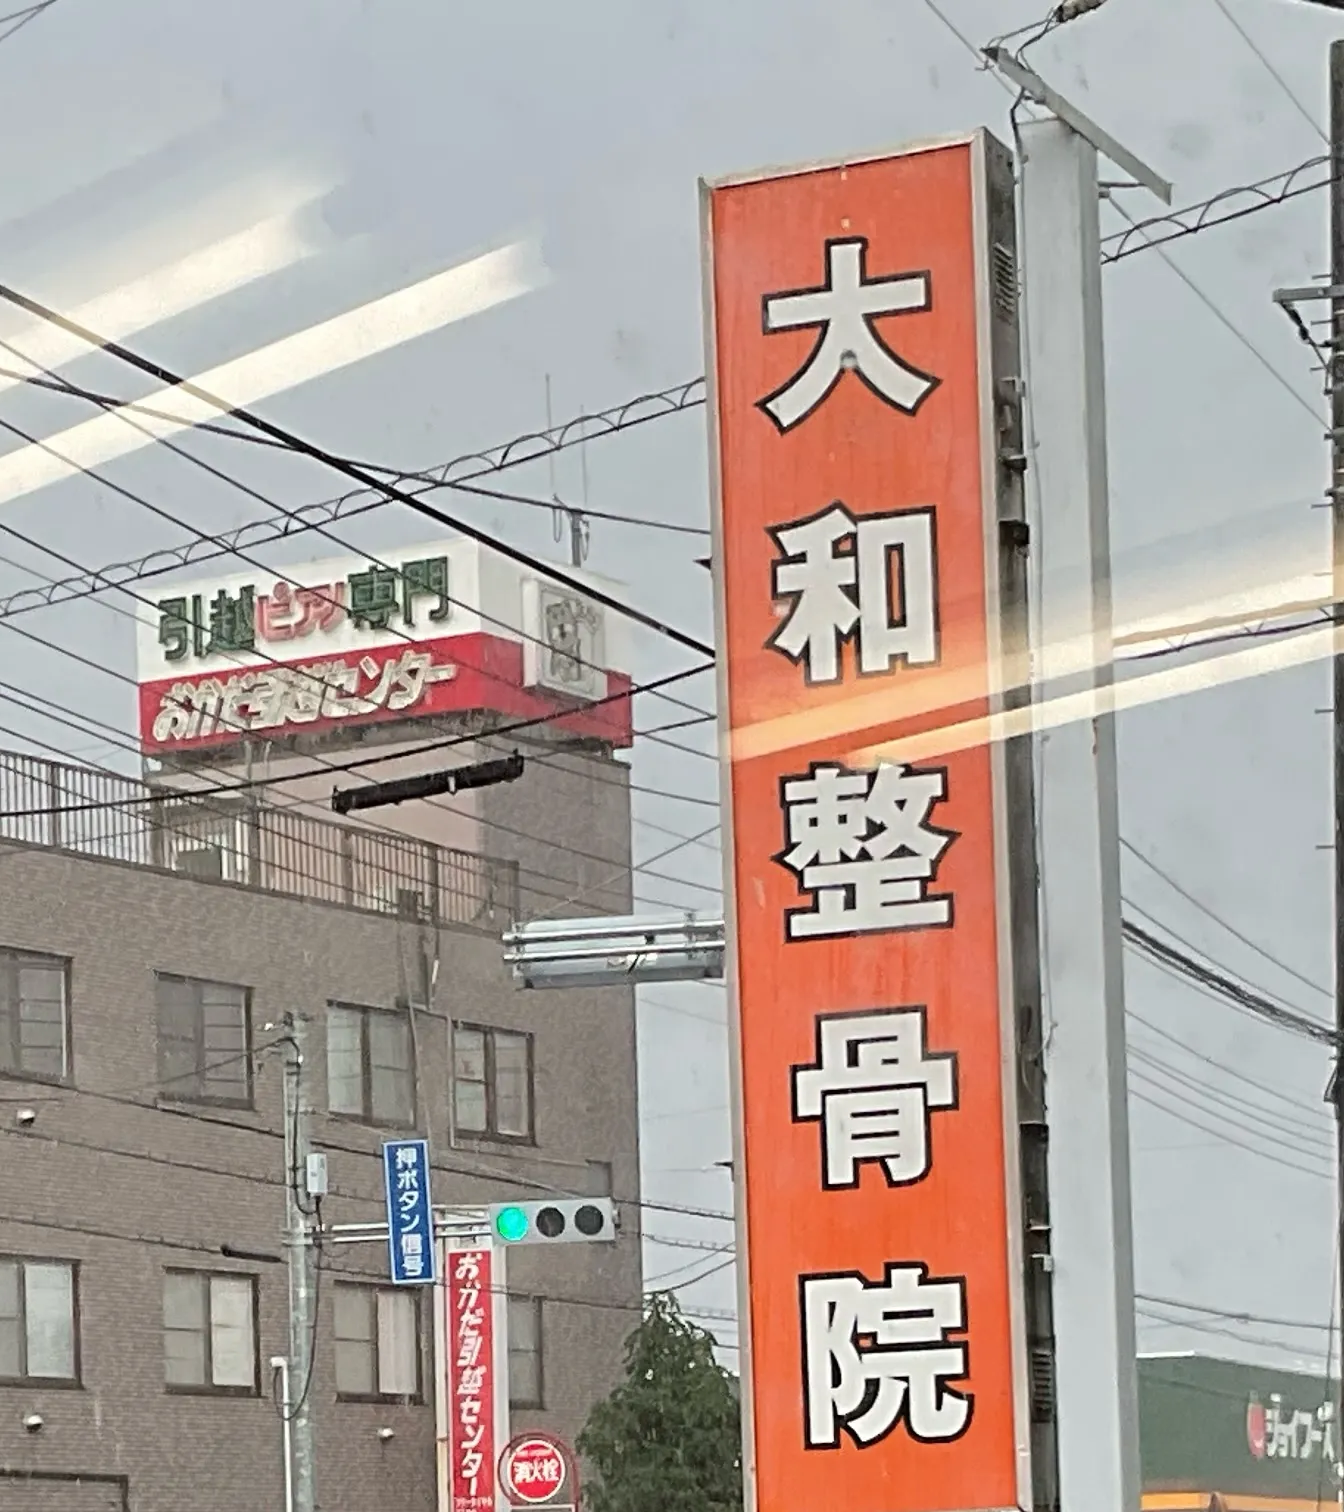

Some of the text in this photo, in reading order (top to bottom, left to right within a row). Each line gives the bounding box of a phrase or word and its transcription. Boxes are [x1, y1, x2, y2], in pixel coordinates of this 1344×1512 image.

[157, 556, 450, 660] 引越ピアノ専門
[761, 237, 974, 1450] 大和整骨院
[395, 1147, 425, 1277] 押ボタン信号
[455, 1252, 487, 1497] おかだ引越センター
[512, 1456, 560, 1484] 消火栓
